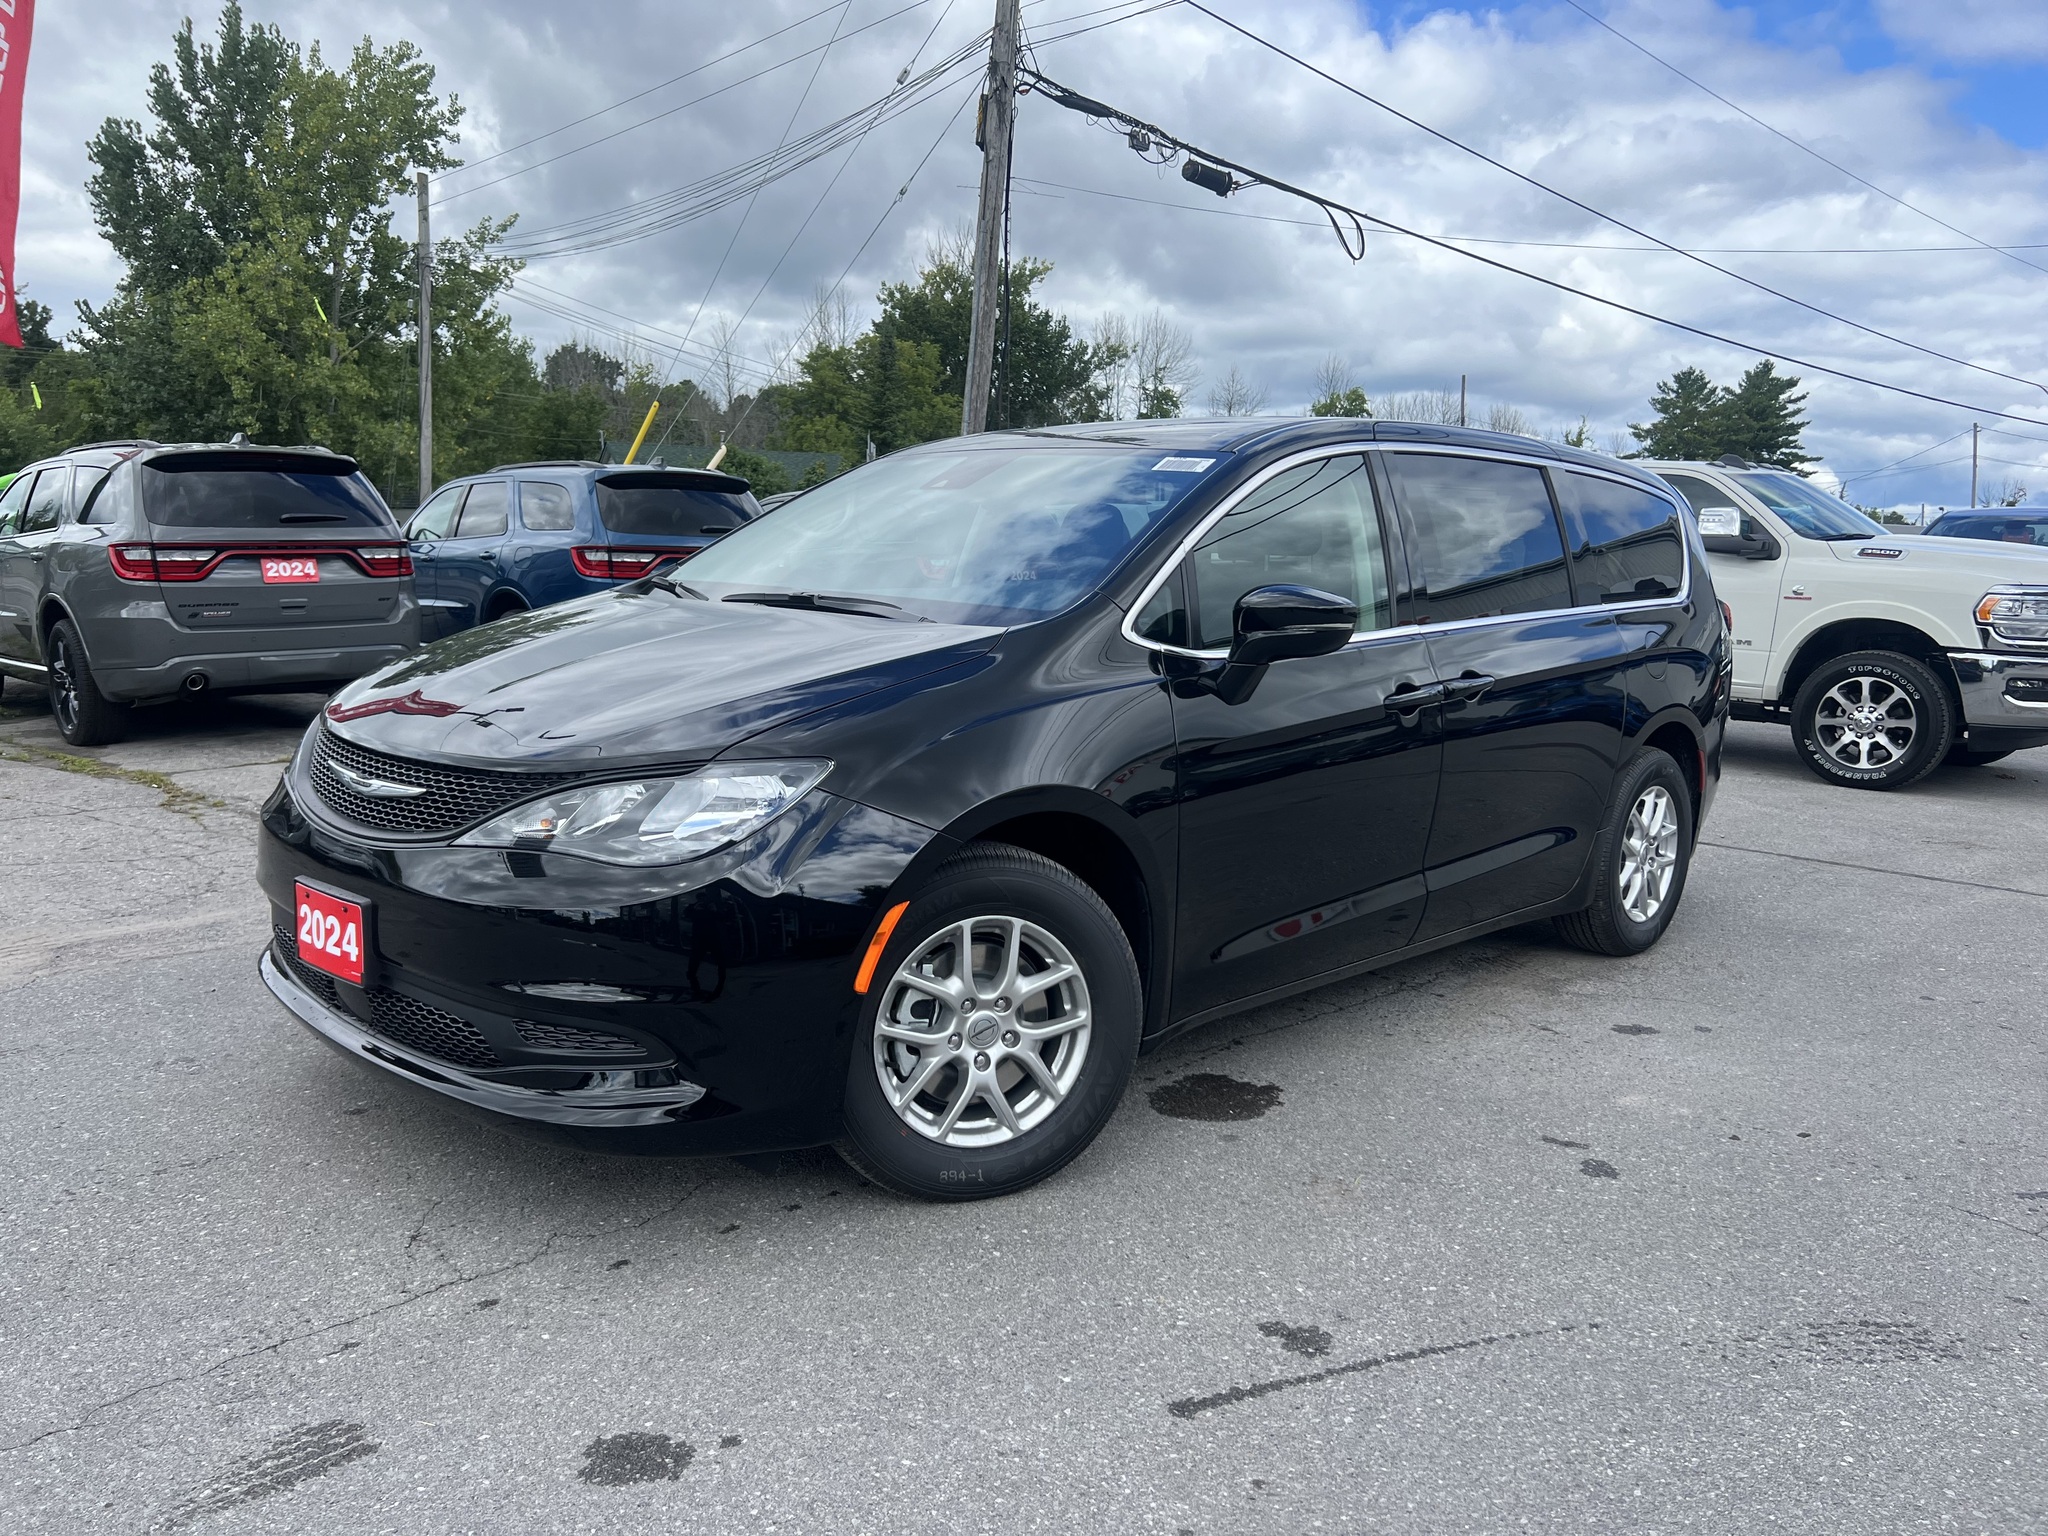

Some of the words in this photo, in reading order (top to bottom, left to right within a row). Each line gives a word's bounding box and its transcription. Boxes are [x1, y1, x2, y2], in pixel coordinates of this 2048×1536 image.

[266, 562, 316, 576] 2024
[1011, 570, 1036, 581] 2024
[300, 904, 359, 962] 2024
